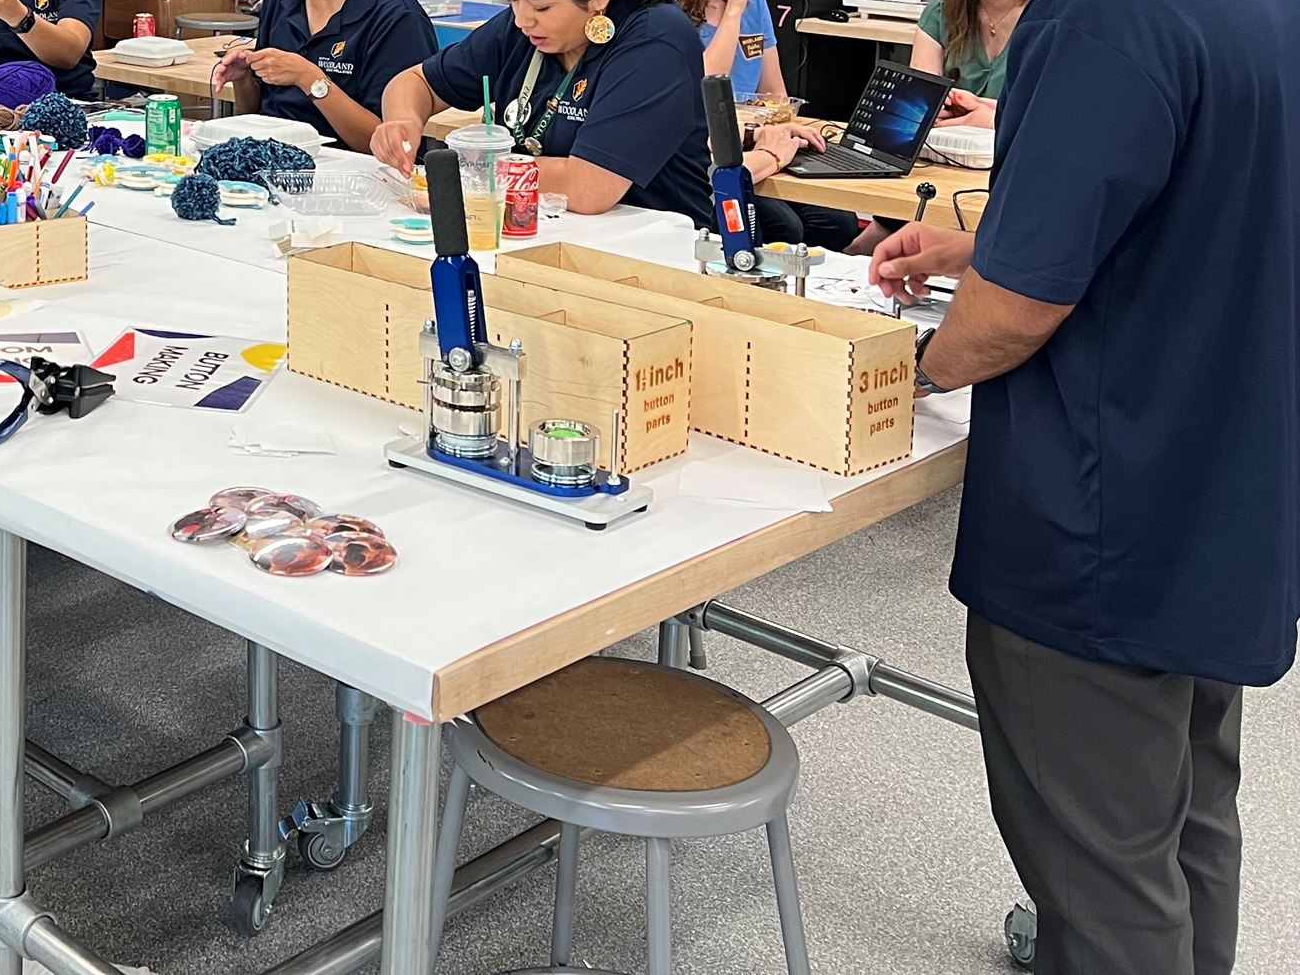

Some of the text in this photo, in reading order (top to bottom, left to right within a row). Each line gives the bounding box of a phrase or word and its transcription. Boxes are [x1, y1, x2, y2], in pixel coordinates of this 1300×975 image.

[777, 4, 792, 28] 7
[318, 60, 354, 71] WOODLAND
[133, 345, 189, 385] MAKING
[175, 351, 230, 391] BUTTON
[650, 358, 684, 388] inch
[859, 360, 909, 394] 3 inch
[644, 394, 675, 413] button
[867, 397, 899, 415] button
[646, 414, 671, 434] parts
[869, 418, 895, 437] parts
